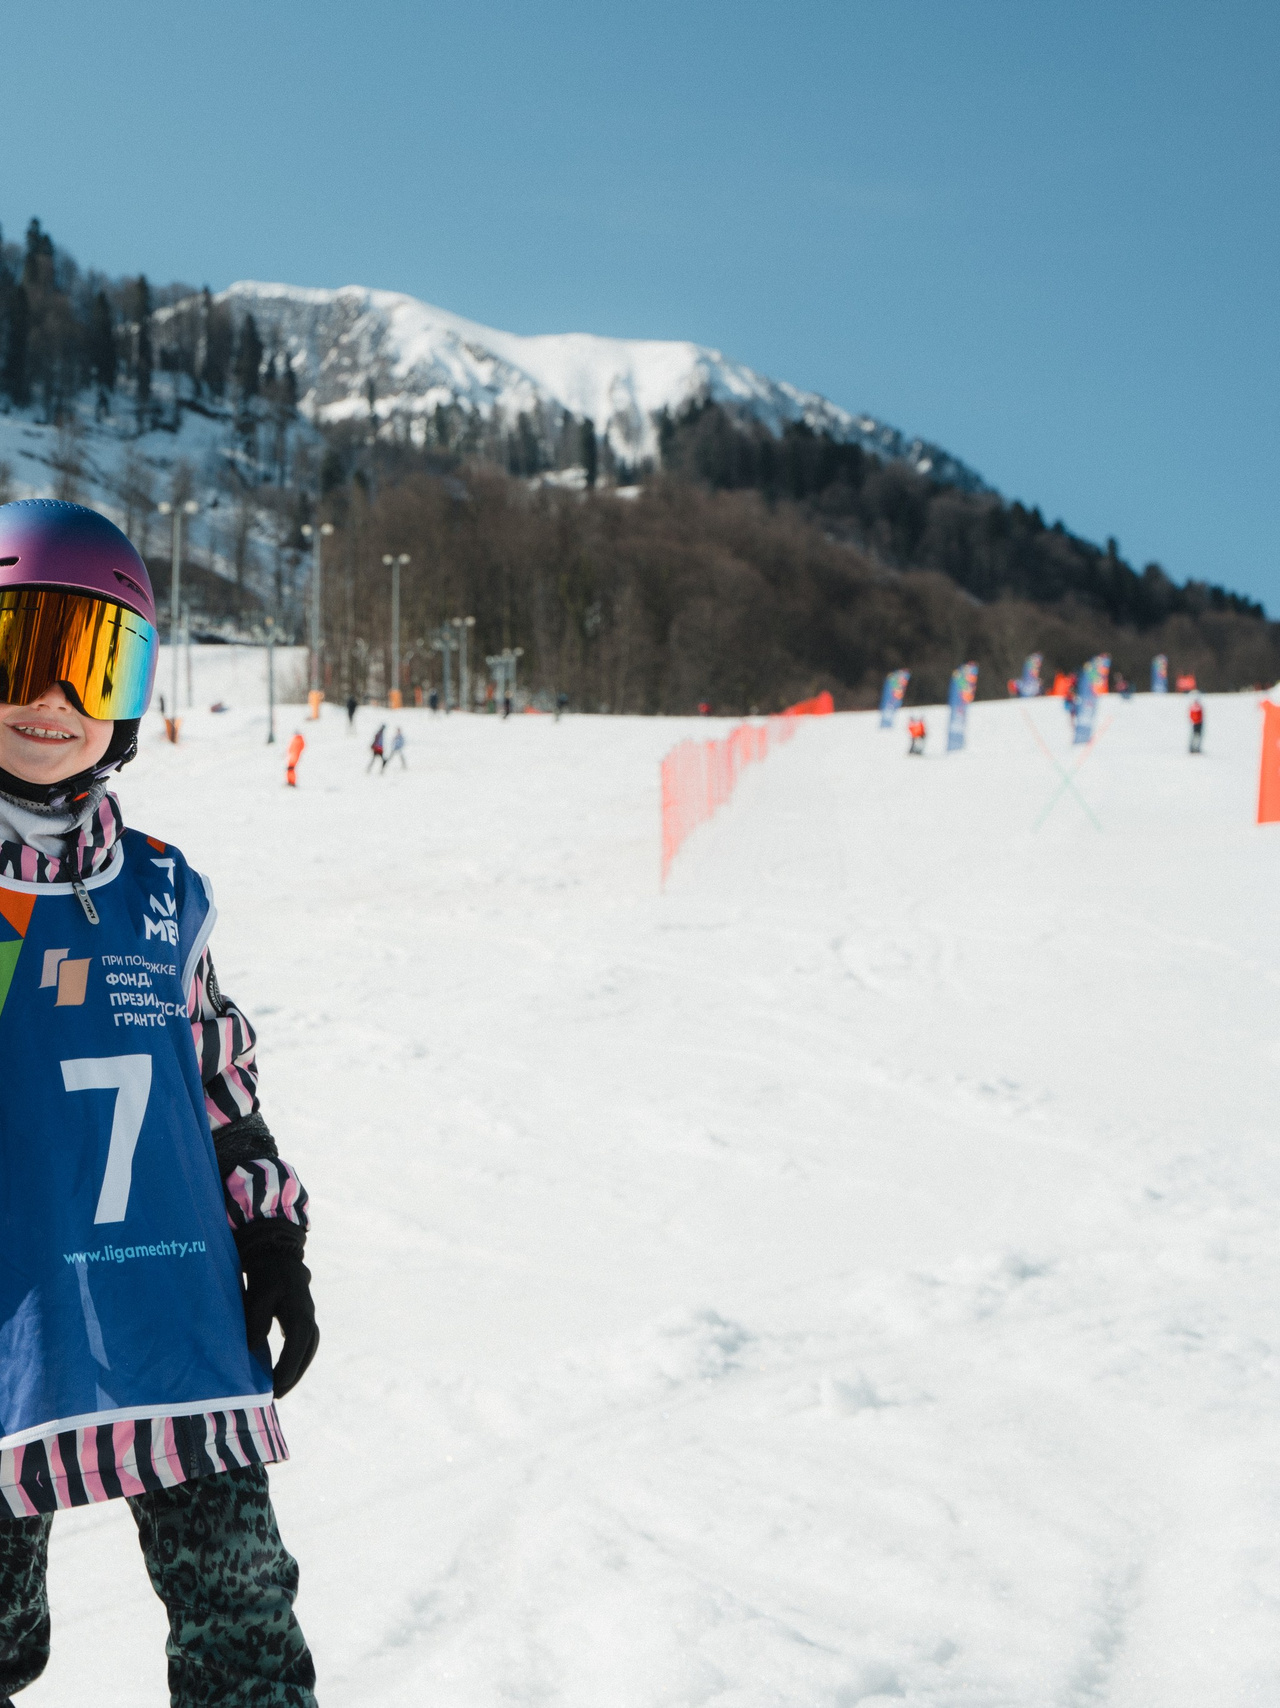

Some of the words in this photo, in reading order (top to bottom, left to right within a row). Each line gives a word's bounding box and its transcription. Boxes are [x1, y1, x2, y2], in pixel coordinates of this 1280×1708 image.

[101, 955, 124, 966] ПРИ
[105, 972, 153, 988] ФОНД
[59, 1053, 153, 1225] 7
[63, 1240, 207, 1264] www.ligamechty.ru
